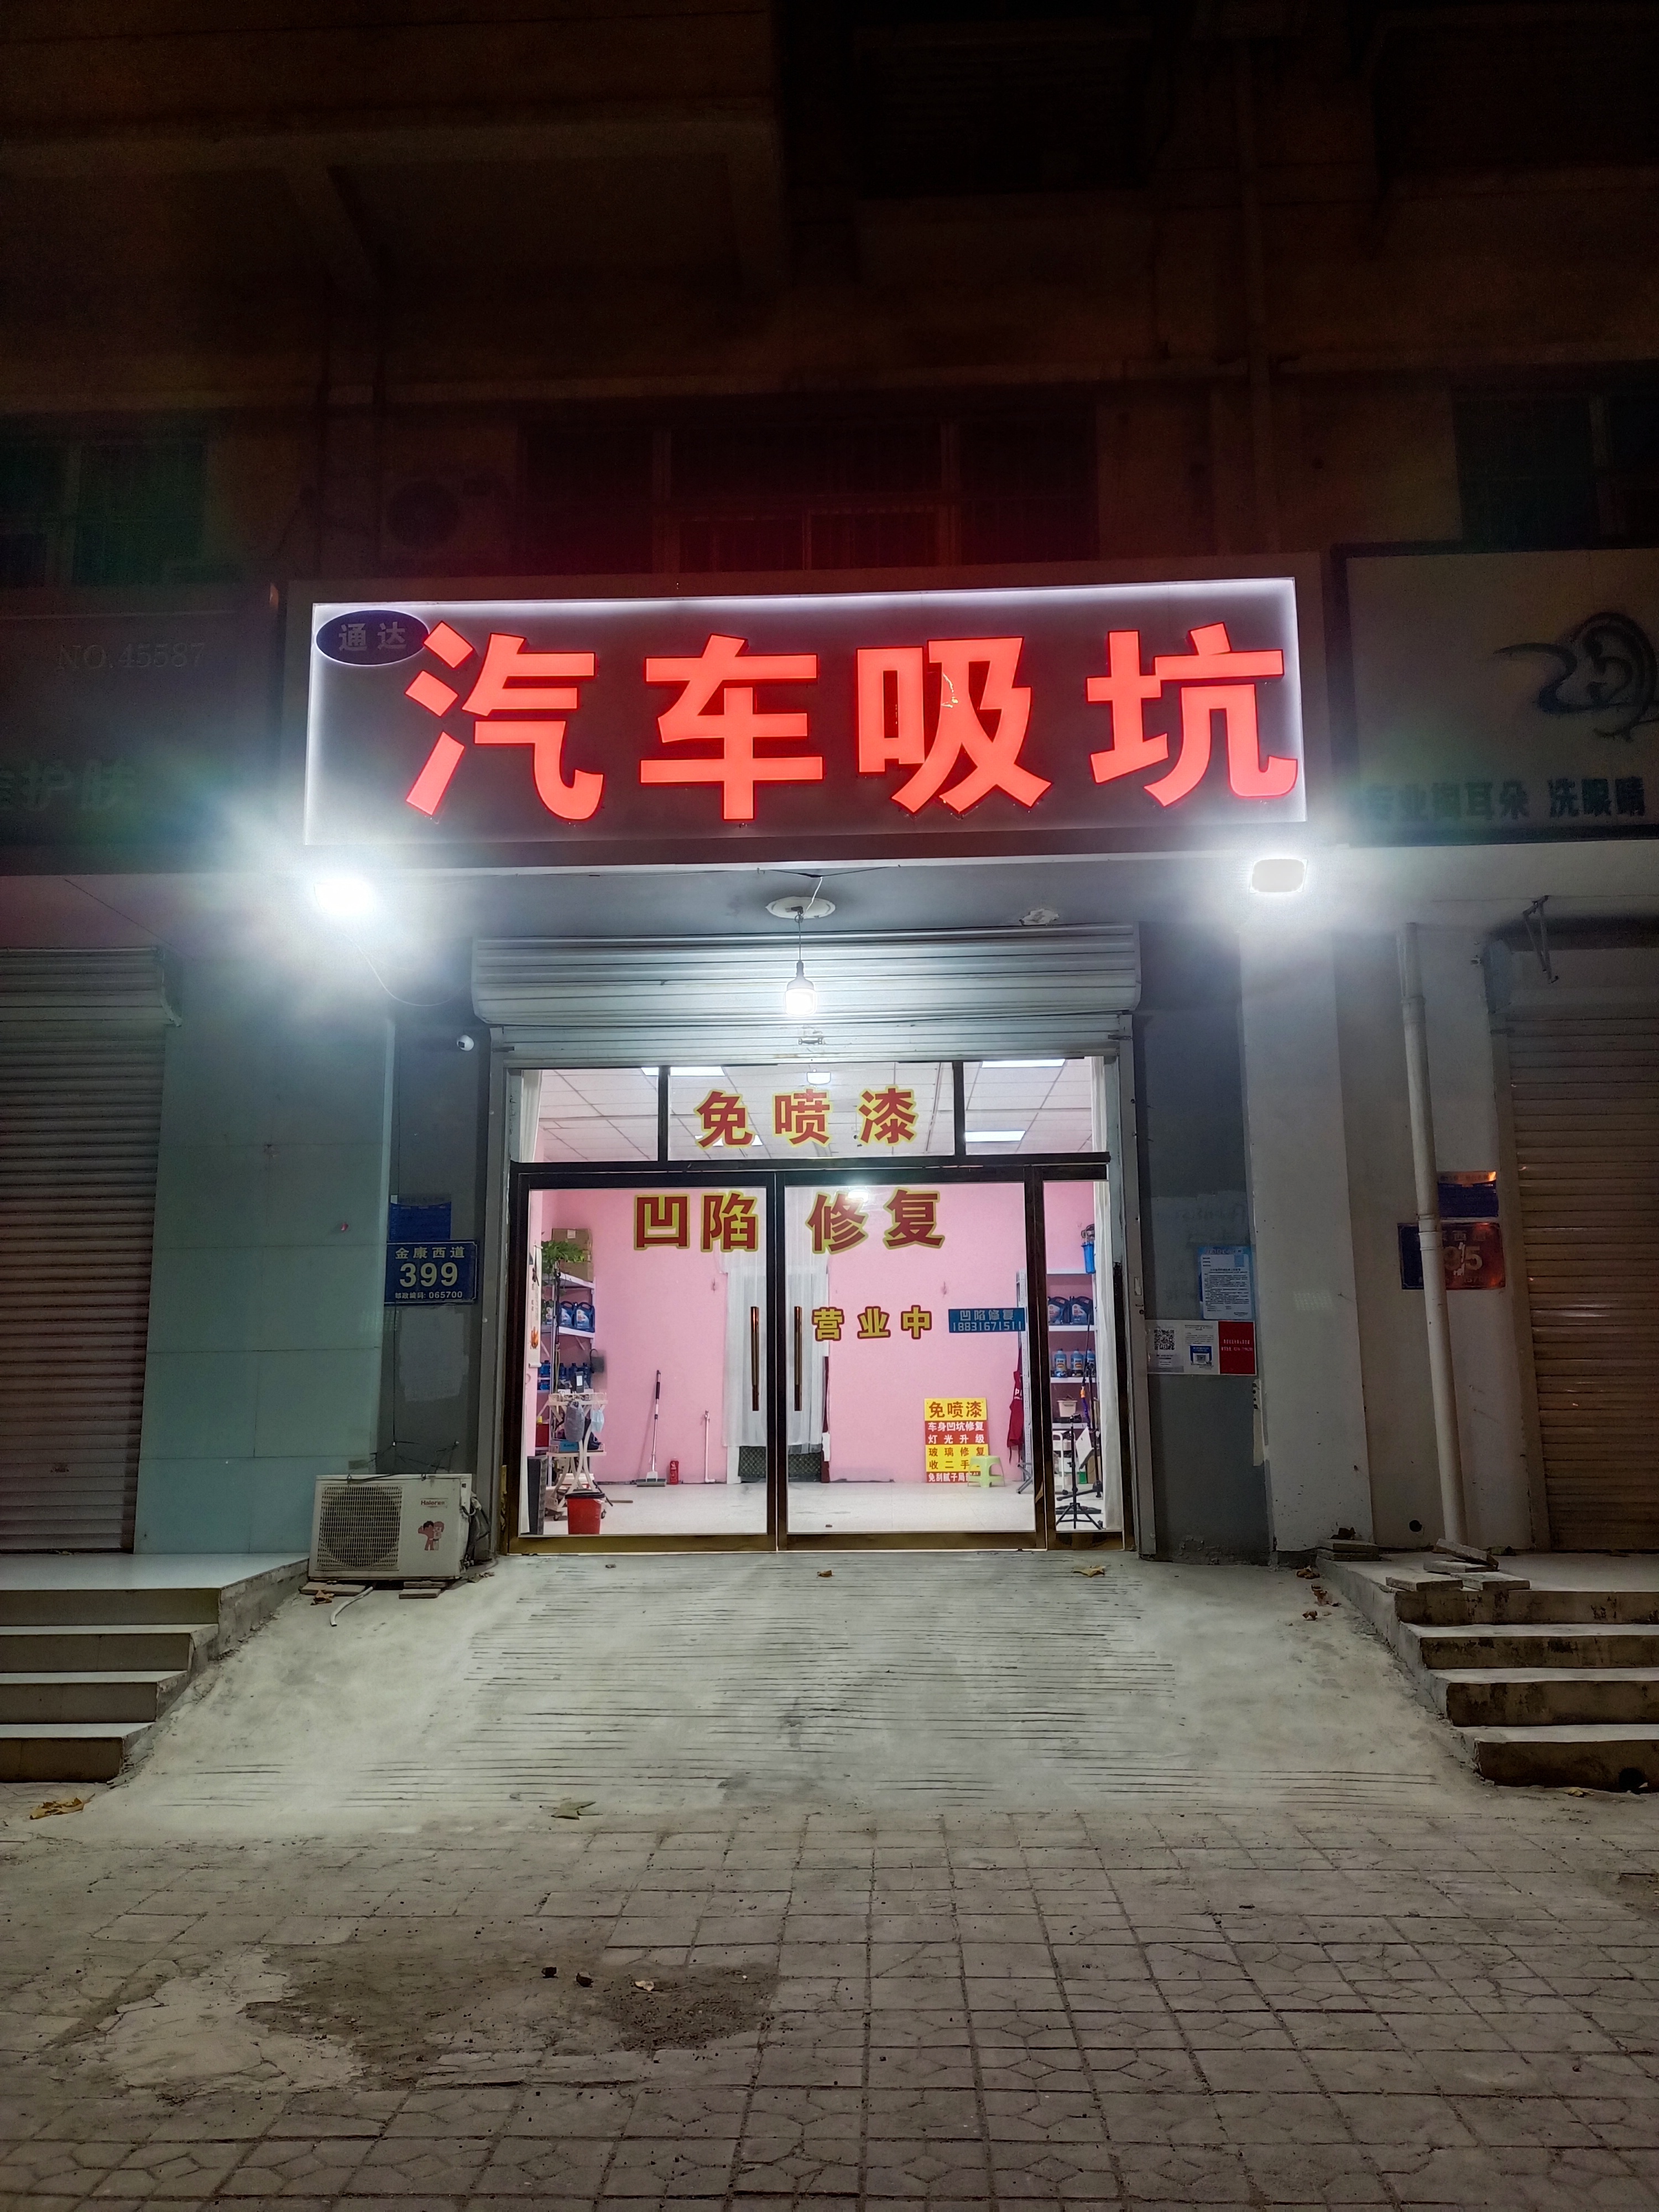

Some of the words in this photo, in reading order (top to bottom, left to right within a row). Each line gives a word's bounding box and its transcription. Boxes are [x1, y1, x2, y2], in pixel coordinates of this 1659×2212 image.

[338, 622, 407, 651] 通达
[56, 641, 207, 671] NO.45587
[405, 622, 1297, 820] 汽车吸坑
[695, 1084, 918, 1150] 免喷漆
[634, 1188, 945, 1254] 凹陷修复
[395, 1246, 465, 1259] 金康西道
[399, 1262, 458, 1287] 399
[811, 1305, 932, 1341] 营业中
[959, 1310, 1014, 1321] 凹陷修复
[953, 1321, 1021, 1332] 18831671511
[928, 1401, 982, 1418] 免喷漆
[928, 1421, 984, 1432] 车身凹坑修复
[928, 1434, 985, 1444] 灯光升级
[929, 1460, 980, 1469] 收二手
